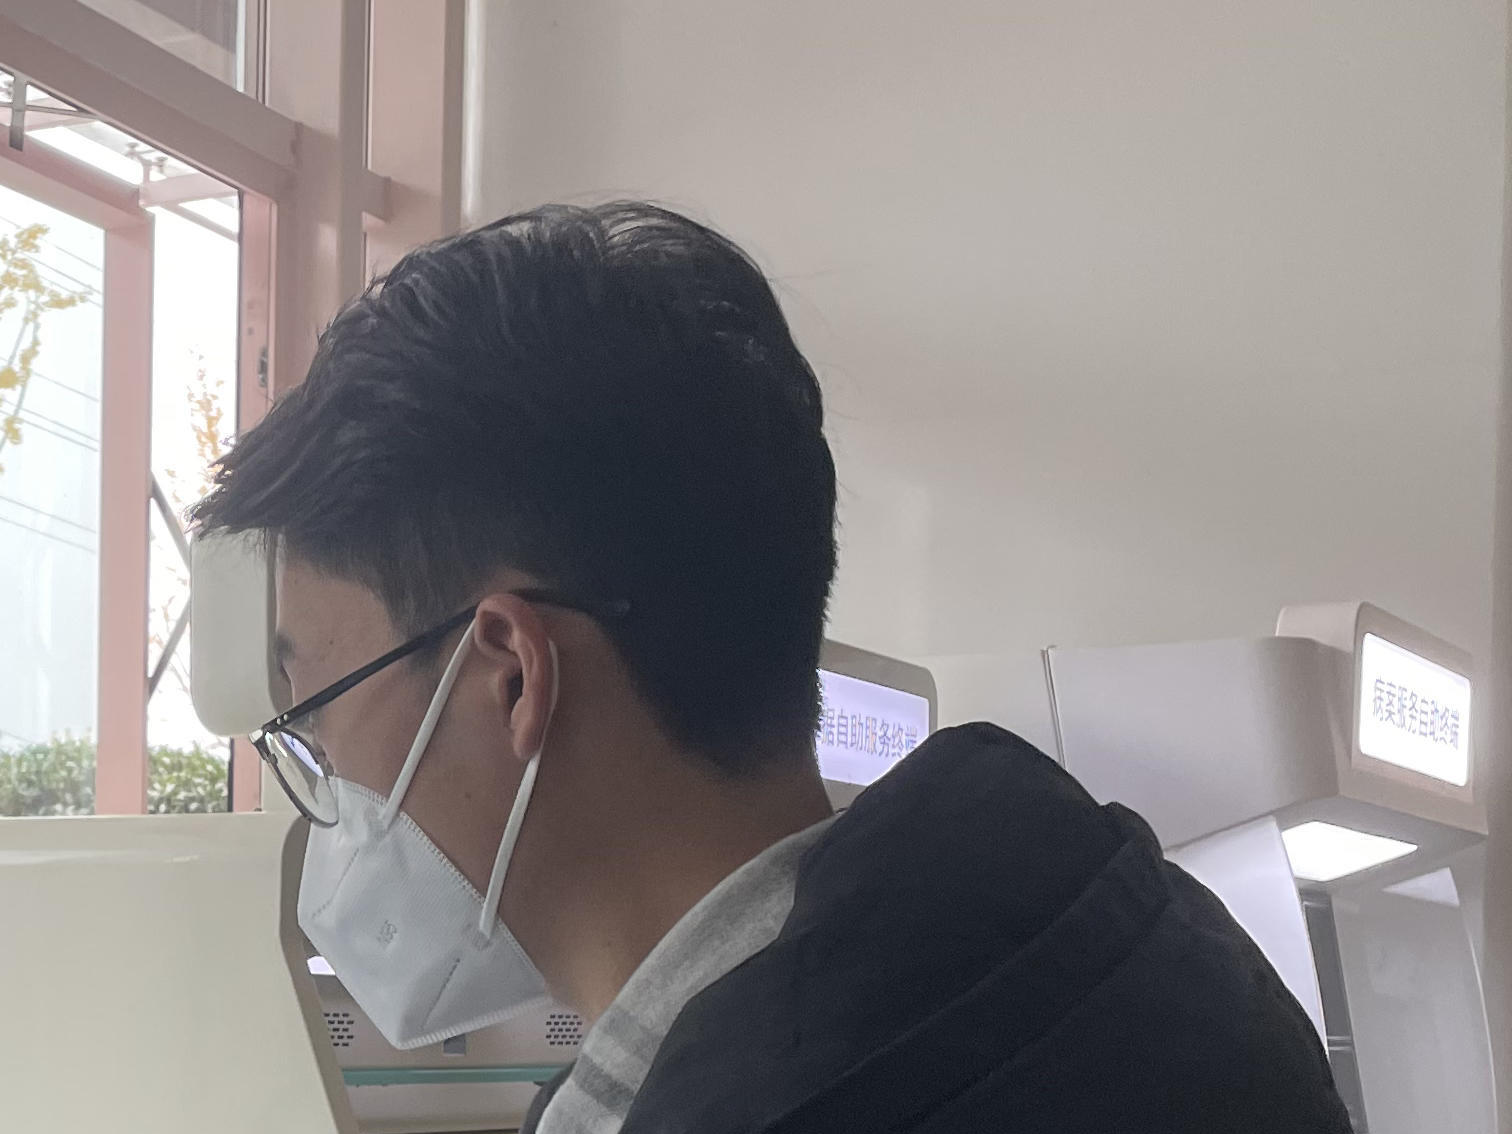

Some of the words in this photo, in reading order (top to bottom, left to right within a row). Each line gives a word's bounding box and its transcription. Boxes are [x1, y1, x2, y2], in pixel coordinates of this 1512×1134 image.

[1372, 676, 1460, 751] 病案服务自助终端
